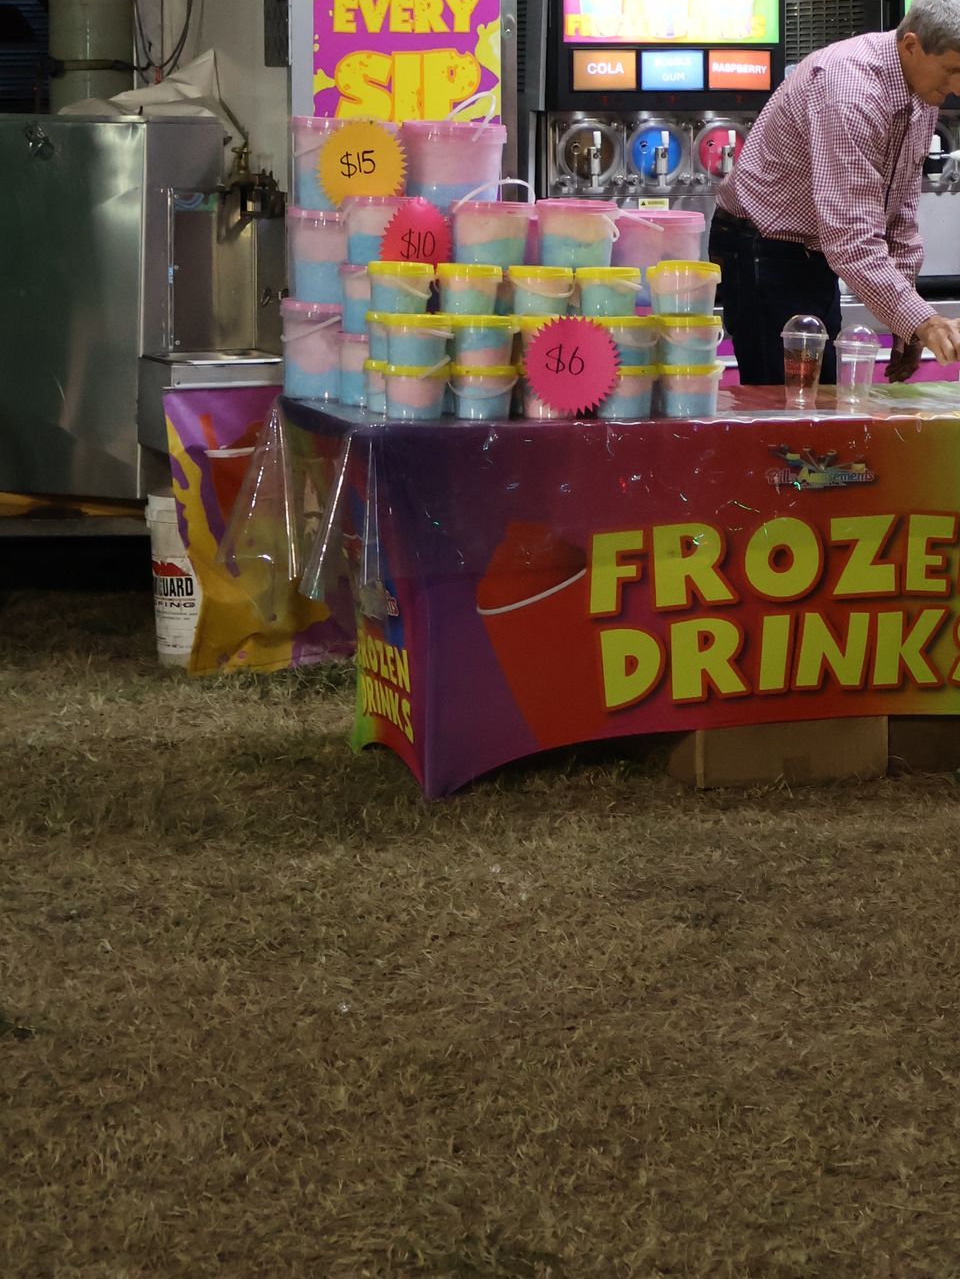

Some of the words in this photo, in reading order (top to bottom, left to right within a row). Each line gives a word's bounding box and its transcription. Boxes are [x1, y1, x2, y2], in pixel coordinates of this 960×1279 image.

[587, 62, 625, 75] COLA
[662, 73, 686, 82] GUM
[711, 63, 768, 75] RASPBERRY
[334, 48, 482, 121] SIP
[339, 149, 377, 179] $15
[399, 228, 437, 260] $10
[544, 344, 586, 376] $6
[361, 672, 414, 745] DRINKS
